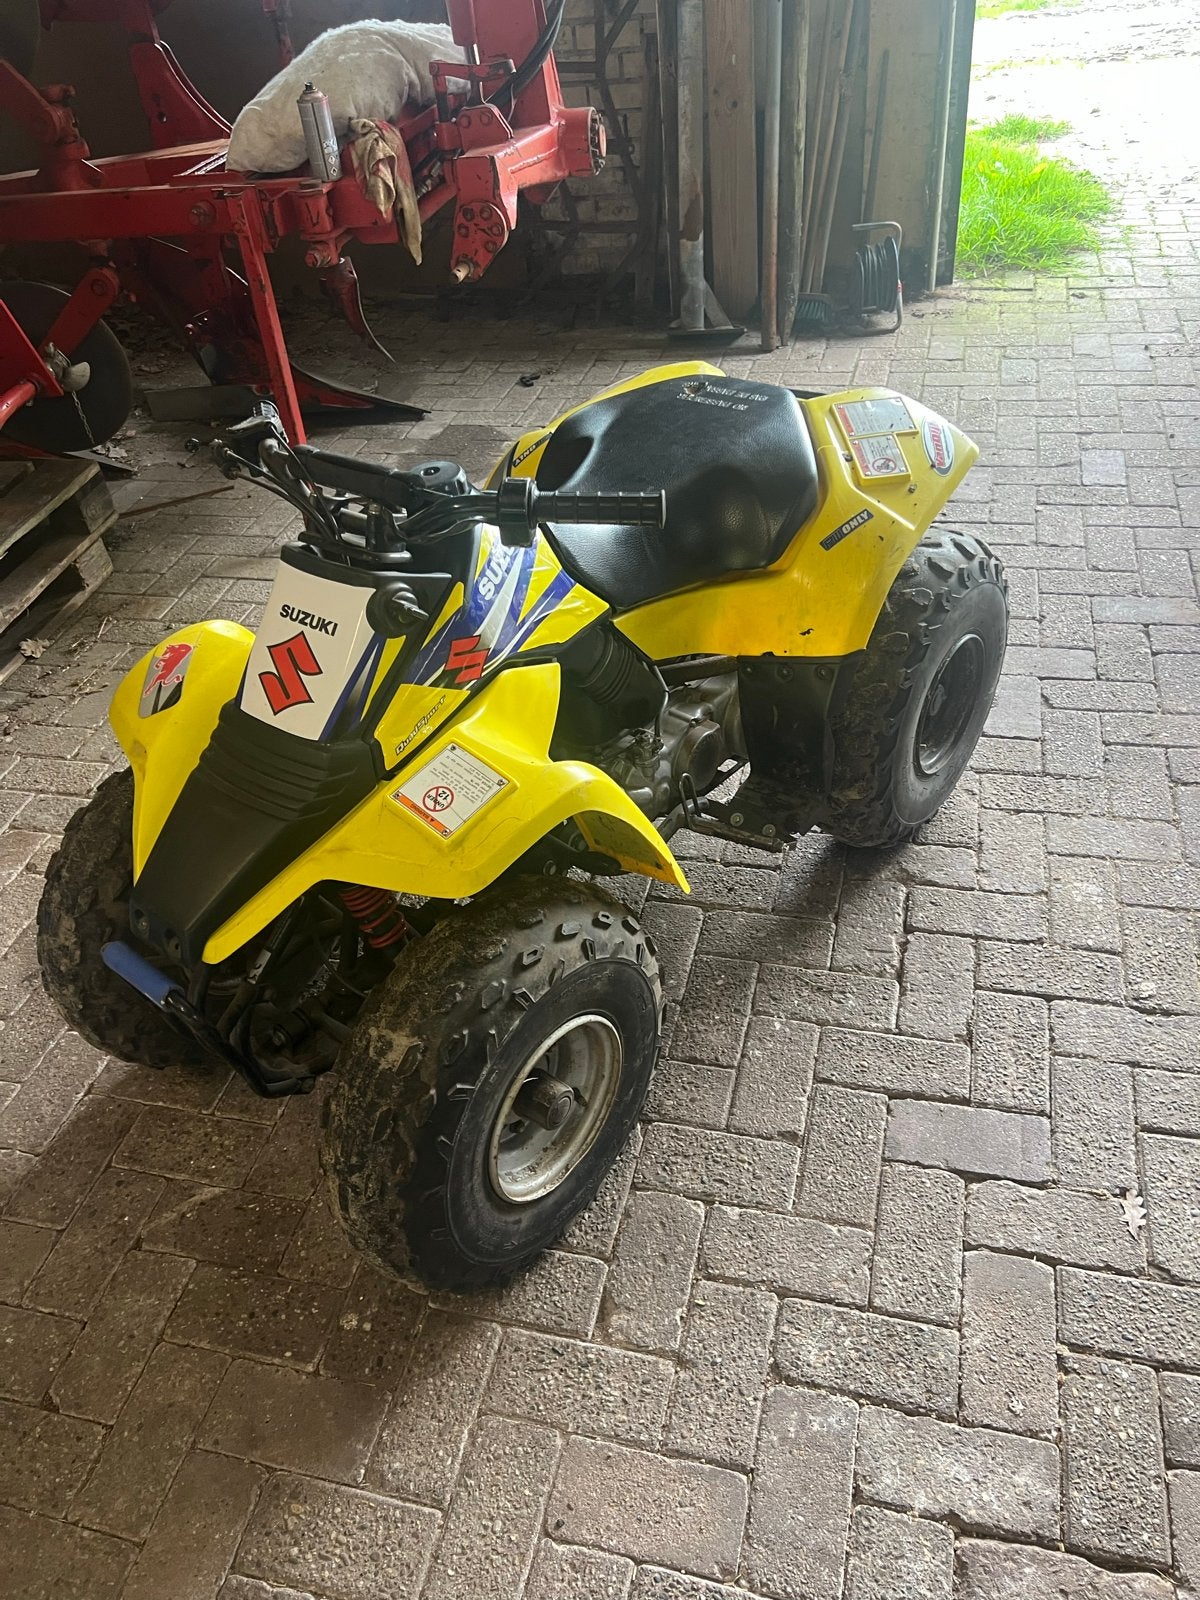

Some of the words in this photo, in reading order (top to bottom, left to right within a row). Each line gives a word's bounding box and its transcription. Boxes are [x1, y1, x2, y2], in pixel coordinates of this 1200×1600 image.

[841, 510, 869, 534] ONLY
[279, 603, 339, 637] SUZUKI
[394, 694, 447, 756] QuadSport
[438, 790, 450, 801] 12
